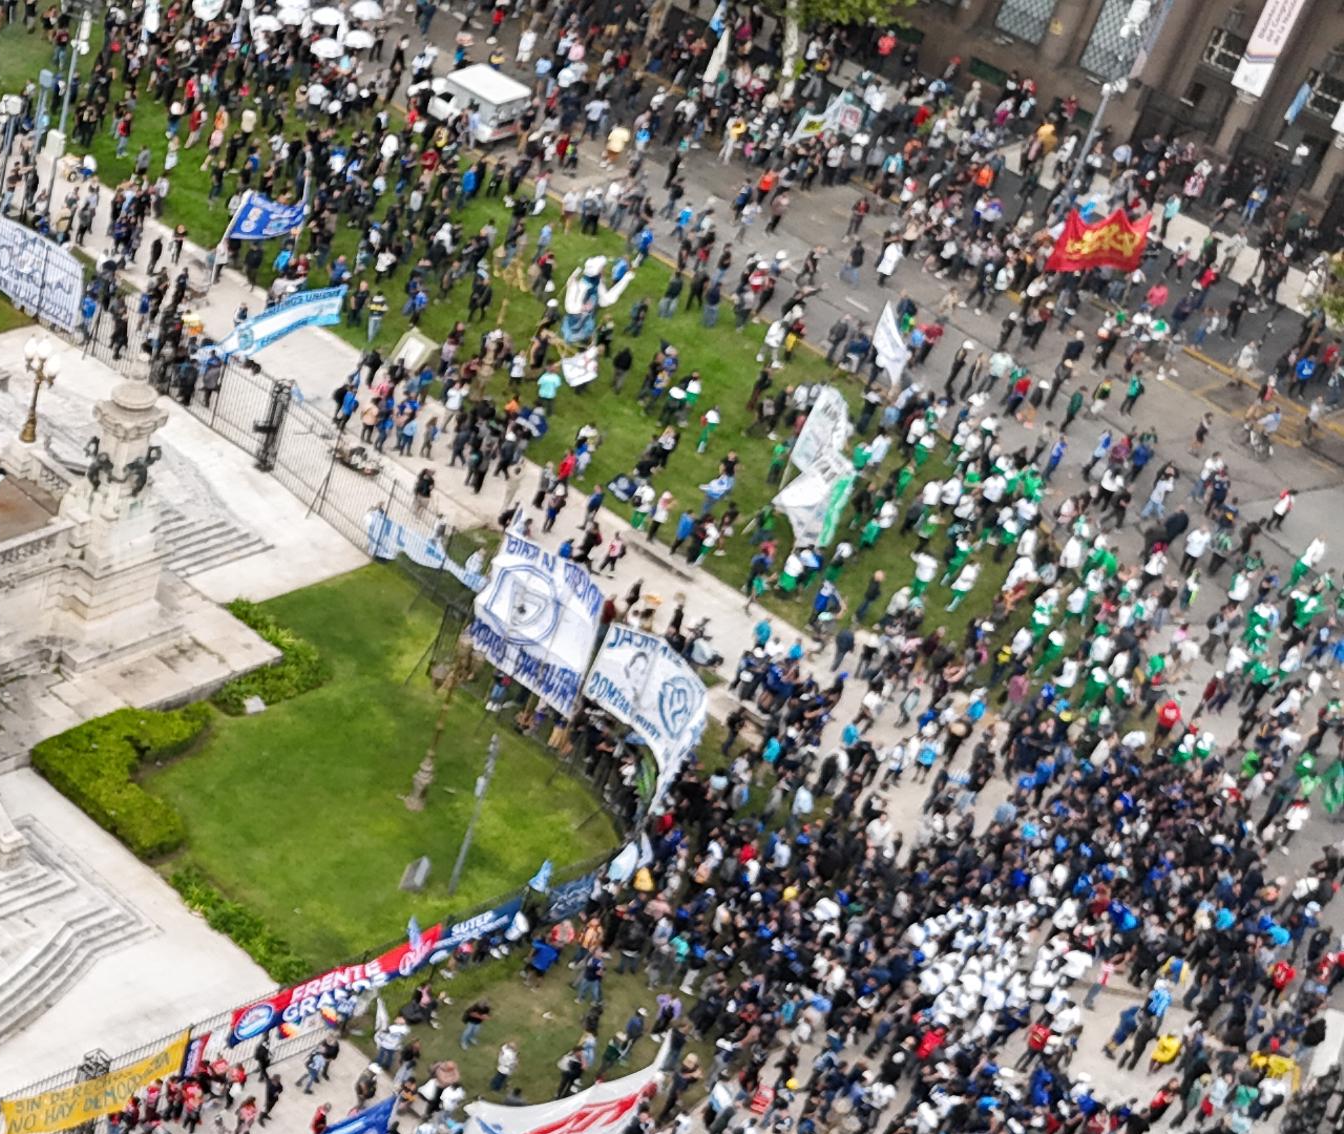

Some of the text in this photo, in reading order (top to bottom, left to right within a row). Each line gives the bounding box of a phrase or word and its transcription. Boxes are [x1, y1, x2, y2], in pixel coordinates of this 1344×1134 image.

[290, 960, 382, 1003] FRENTE
[10, 1113, 37, 1133] NO
[44, 1101, 76, 1126] HAY
[15, 1097, 41, 1114] SIN
